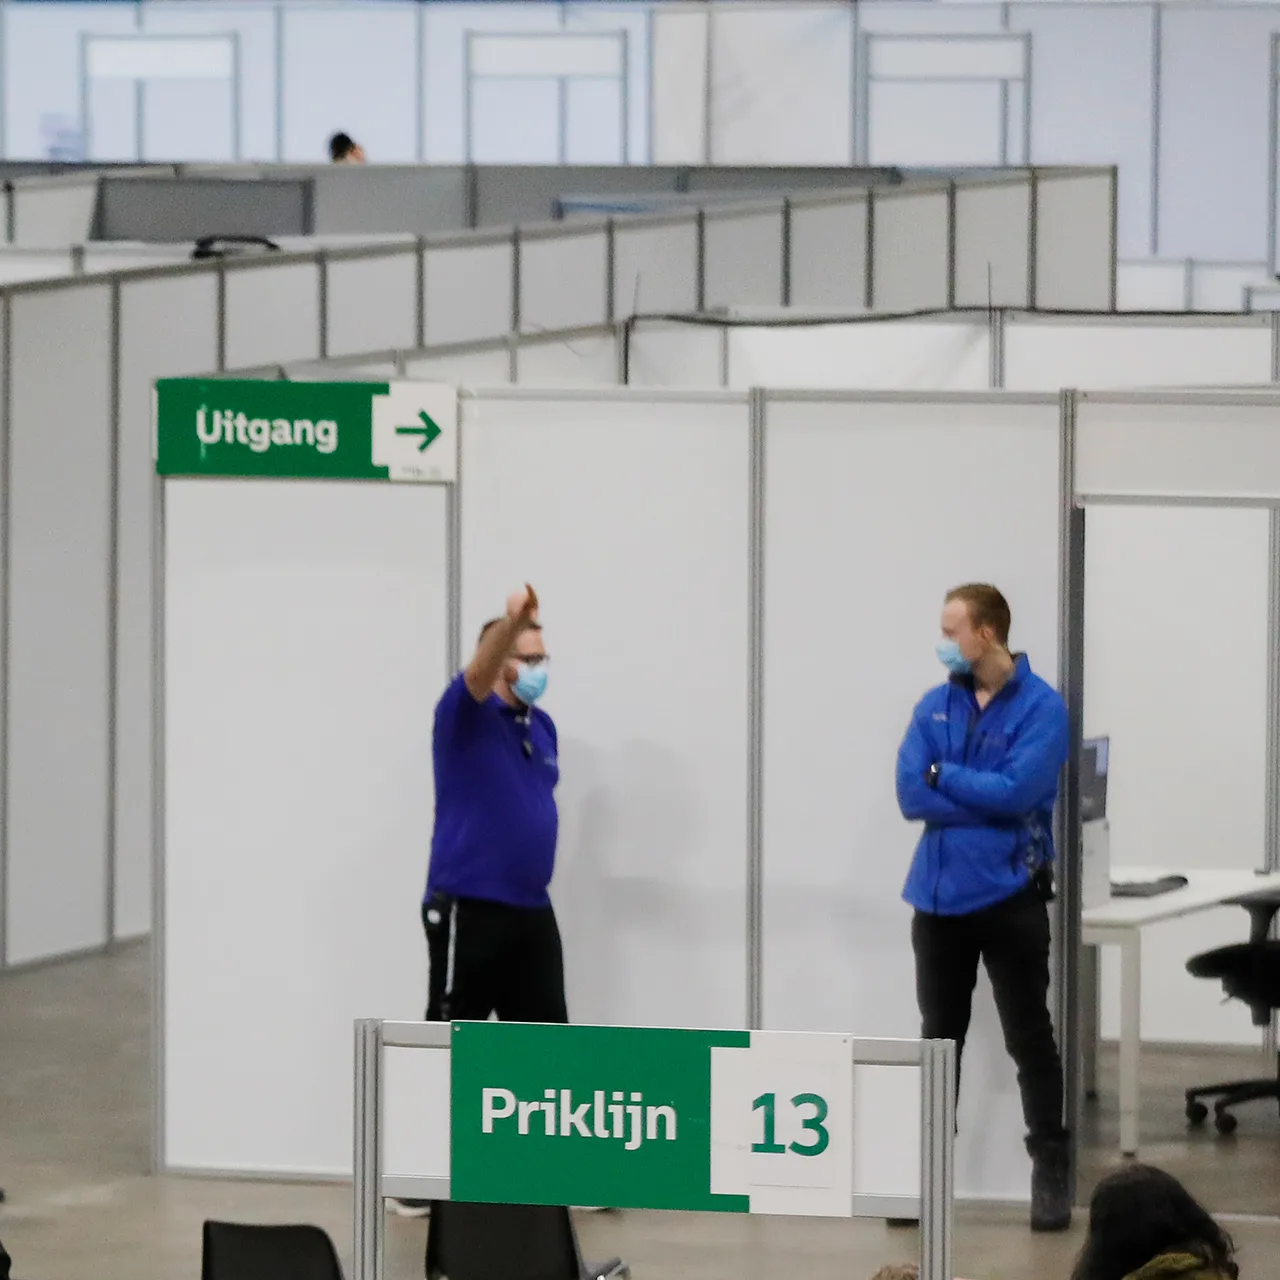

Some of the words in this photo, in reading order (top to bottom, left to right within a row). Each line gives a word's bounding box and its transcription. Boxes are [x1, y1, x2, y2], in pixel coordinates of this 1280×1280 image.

[196, 408, 338, 453] Uitgang
[481, 1087, 677, 1151] Priklijn
[751, 1092, 831, 1157] 13
